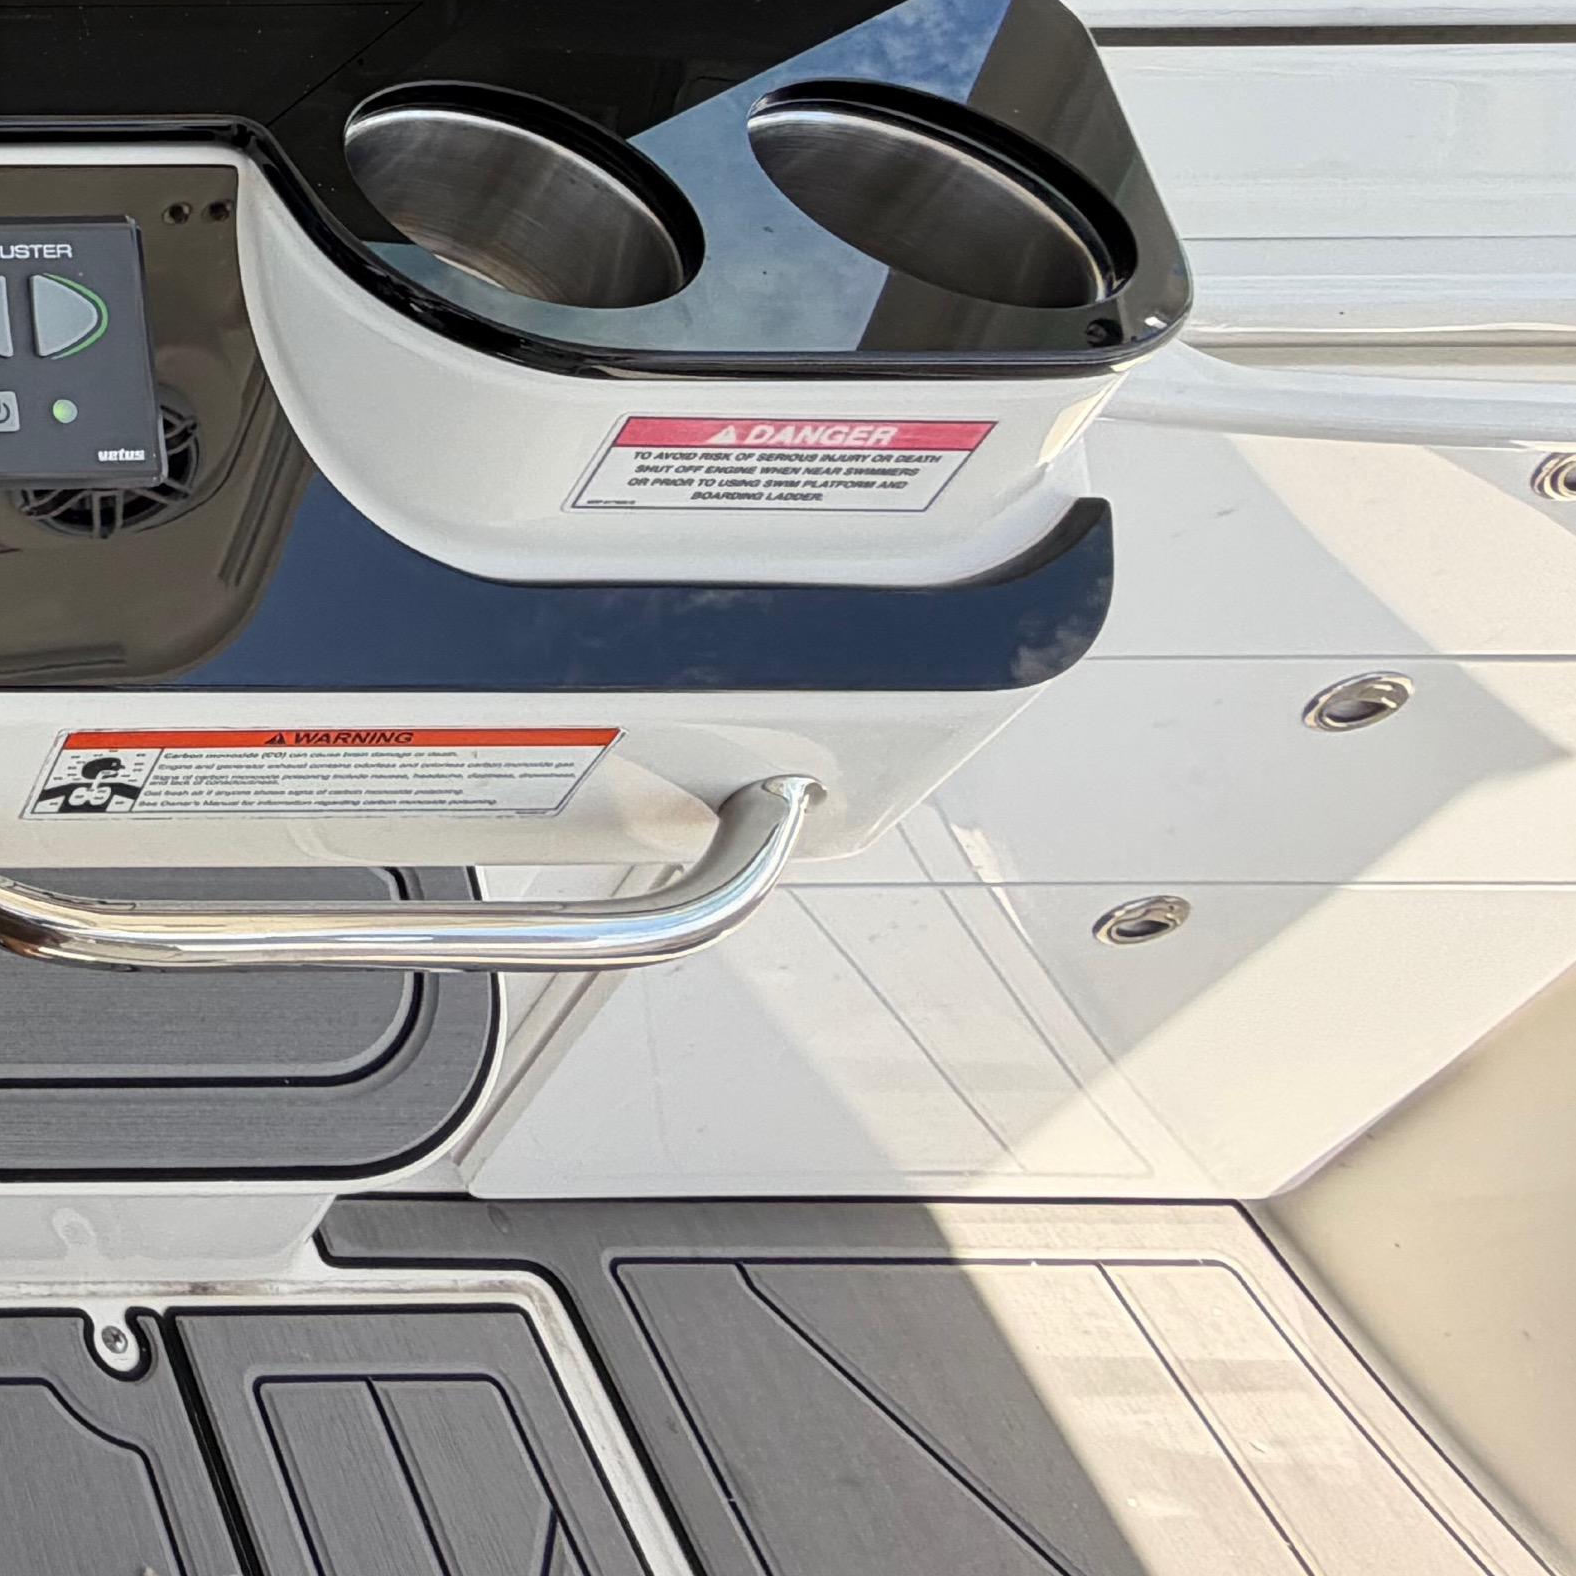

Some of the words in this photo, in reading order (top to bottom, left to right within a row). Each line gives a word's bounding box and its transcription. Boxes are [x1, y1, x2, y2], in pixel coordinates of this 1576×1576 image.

[743, 424, 898, 446] DANGER
[634, 452, 653, 460] TO
[653, 452, 698, 460] AVOID
[699, 452, 732, 461] RISK
[736, 453, 755, 461] OF
[756, 453, 818, 462] SERIOUS
[819, 454, 871, 462] INJURY
[871, 454, 892, 462] OR
[895, 455, 942, 463] DEATH
[635, 465, 675, 473] SHUT
[675, 465, 703, 474] OFF
[704, 466, 757, 474] ENGINE
[759, 466, 802, 475] WHEN
[803, 467, 844, 475] NEAR
[844, 468, 920, 476] SWIMMERS
[627, 478, 649, 486] OR
[651, 478, 695, 486] PRIOR
[698, 479, 717, 487] TO
[717, 479, 761, 487] USING
[763, 480, 800, 488] SWIM
[801, 480, 877, 489] PLATFORM
[877, 481, 909, 489] AND
[691, 491, 764, 500] BOARDING
[294, 732, 414, 744] WARNING
